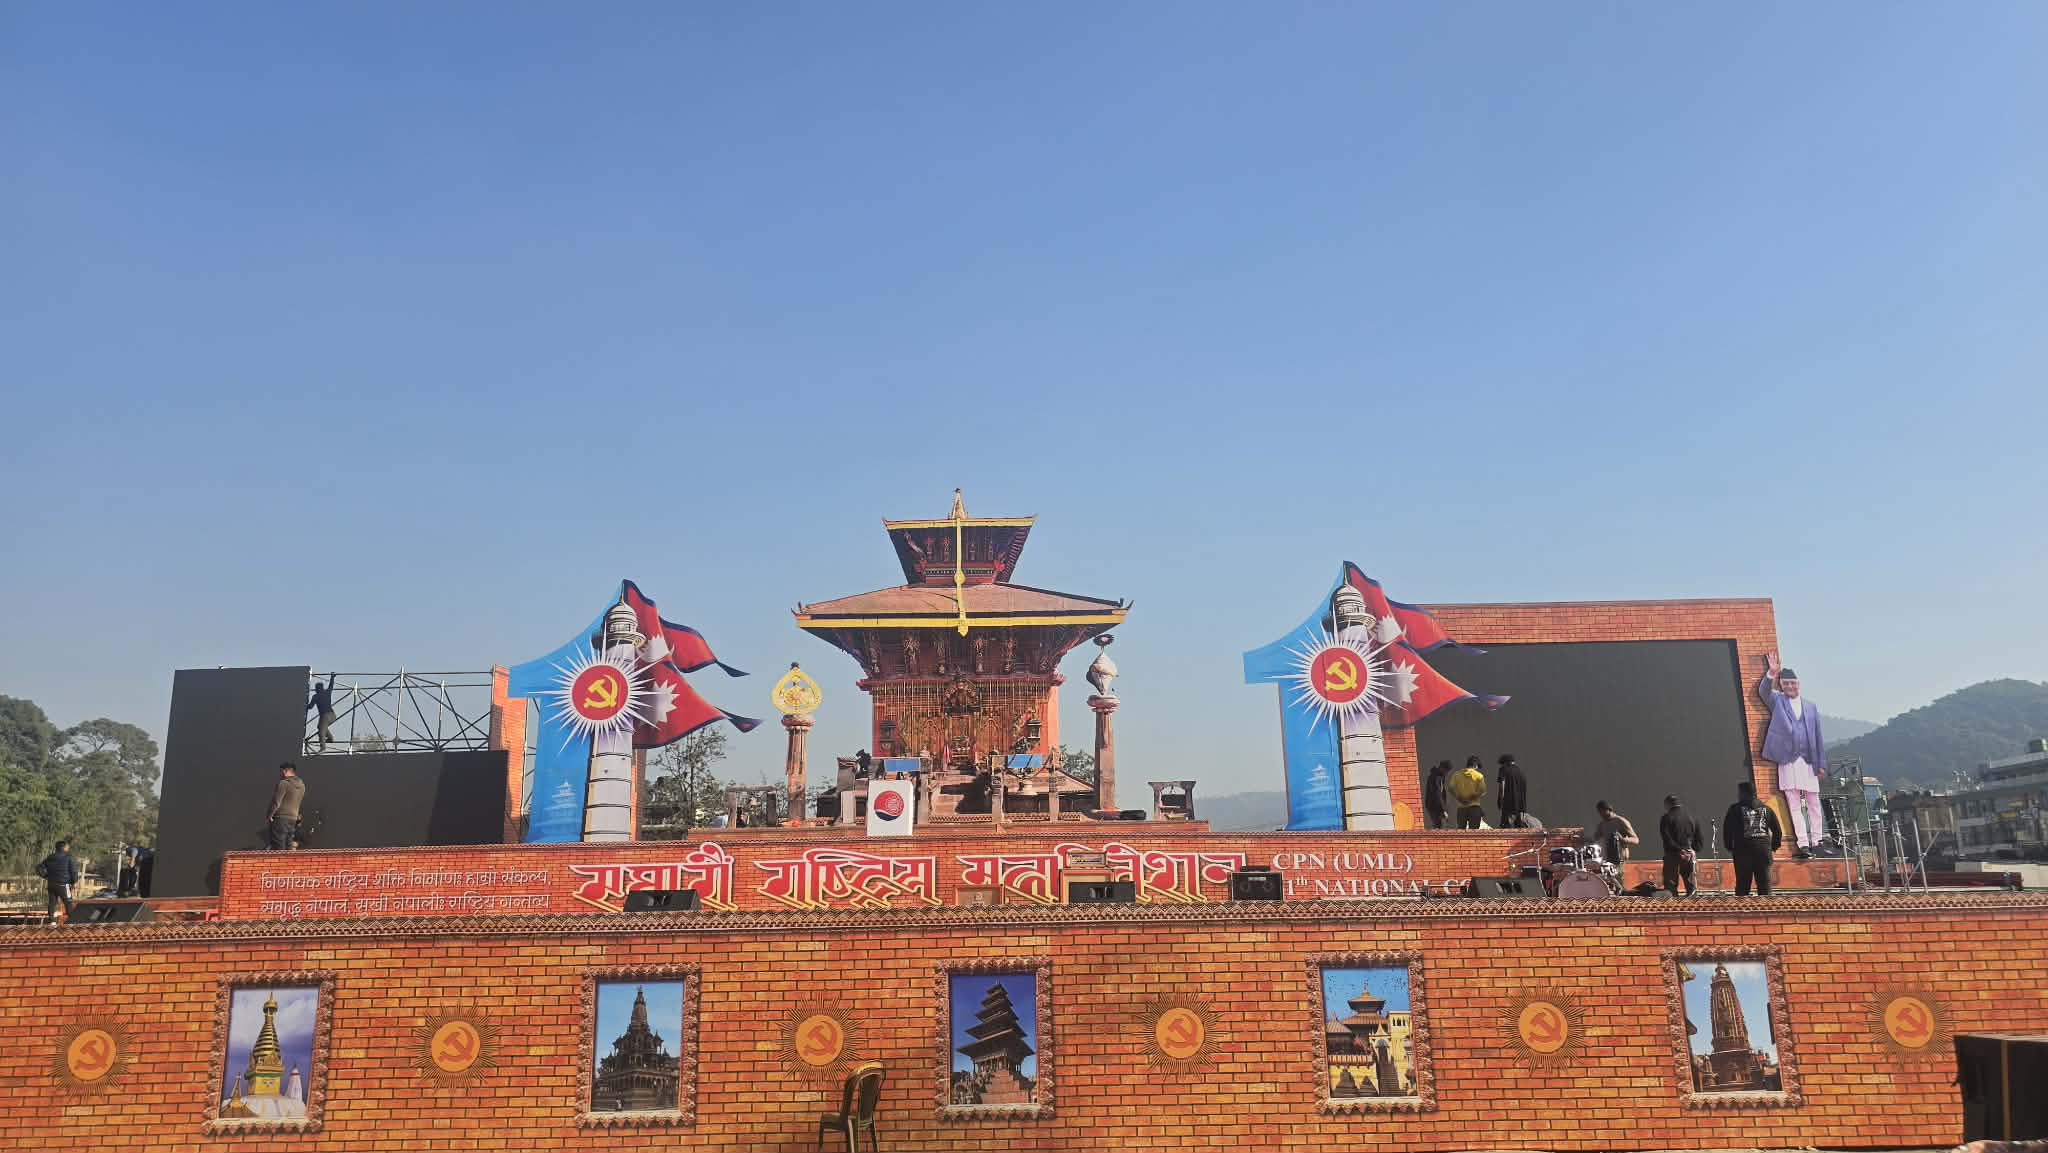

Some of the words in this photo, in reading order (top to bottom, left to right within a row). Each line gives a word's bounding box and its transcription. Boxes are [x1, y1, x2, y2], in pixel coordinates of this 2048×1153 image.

[753, 847, 943, 910] राष्ट्रिय
[1272, 853, 1326, 870] CPN
[1333, 853, 1412, 872] (UML)
